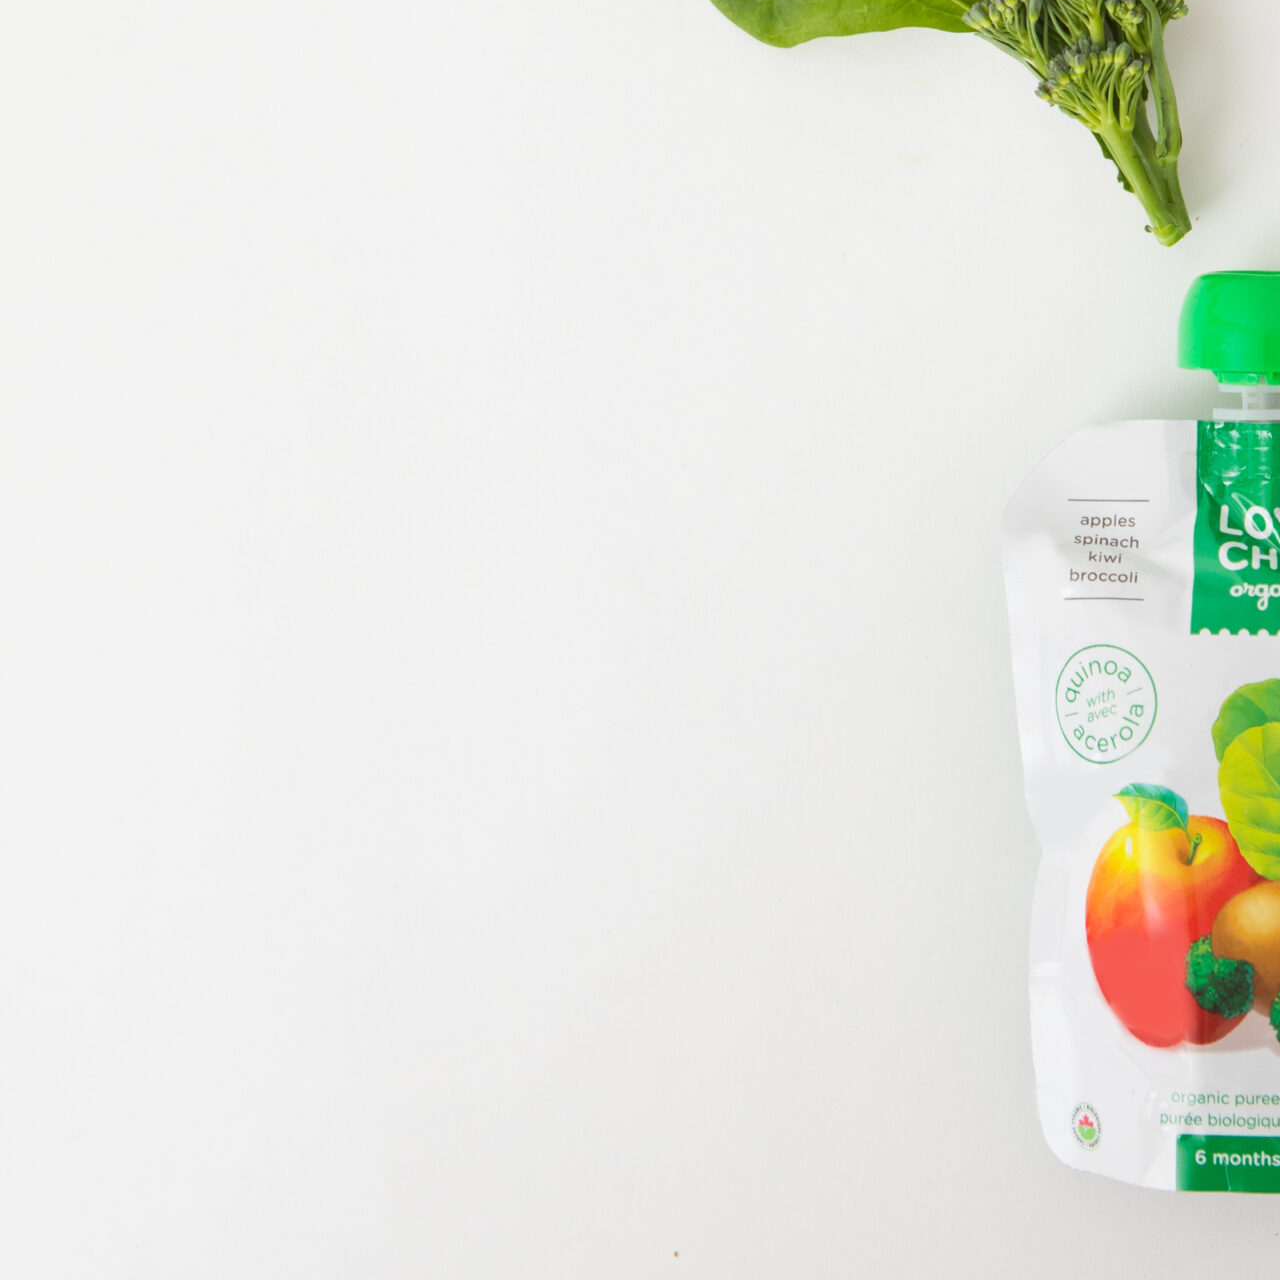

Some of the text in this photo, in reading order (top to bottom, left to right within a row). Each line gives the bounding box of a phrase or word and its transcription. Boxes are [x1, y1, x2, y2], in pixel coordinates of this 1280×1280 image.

[1080, 514, 1136, 529] apples
[1074, 534, 1139, 549] spinach
[1088, 551, 1122, 564] kiwi
[1069, 568, 1138, 584] broccoli
[1065, 660, 1132, 703] quinoa
[1086, 688, 1116, 708] with
[1087, 704, 1117, 723] avec
[1073, 704, 1144, 752] acerola
[1171, 1091, 1229, 1107] organic
[1234, 1095, 1280, 1107] puree
[1160, 1112, 1202, 1127] purée
[1195, 1149, 1207, 1165] 6
[1212, 1151, 1280, 1167] months
